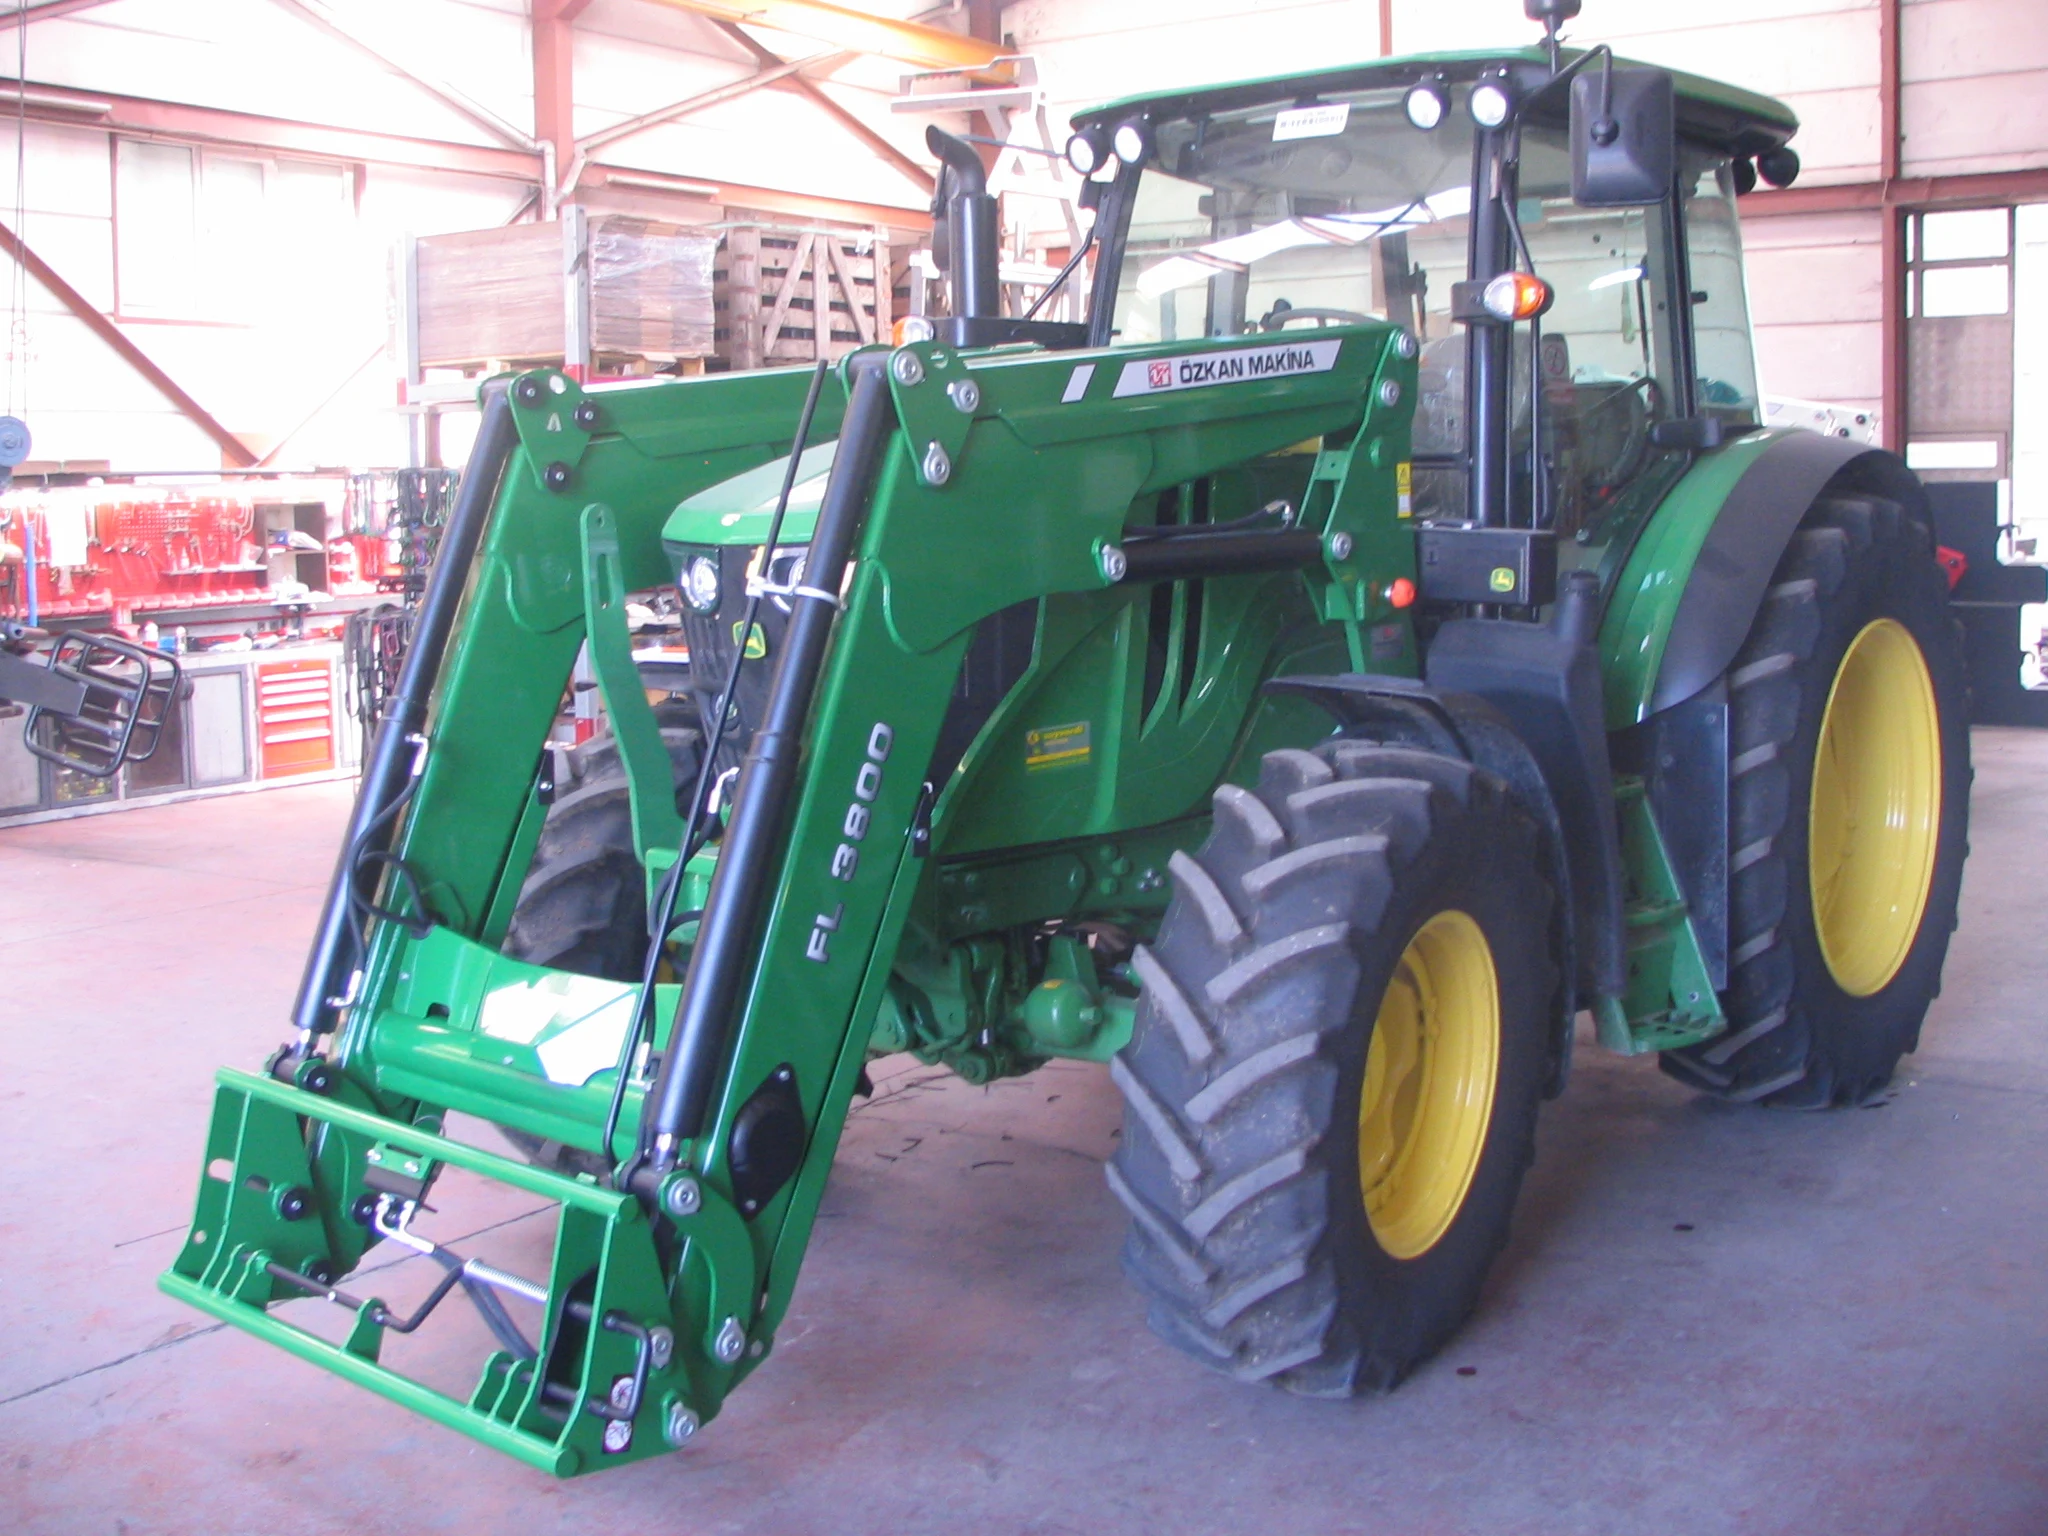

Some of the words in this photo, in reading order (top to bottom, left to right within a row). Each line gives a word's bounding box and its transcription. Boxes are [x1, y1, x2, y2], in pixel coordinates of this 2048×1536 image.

[1179, 359, 1243, 384] ÖZKAN
[806, 902, 845, 963] FL
[831, 721, 894, 882] 3800
